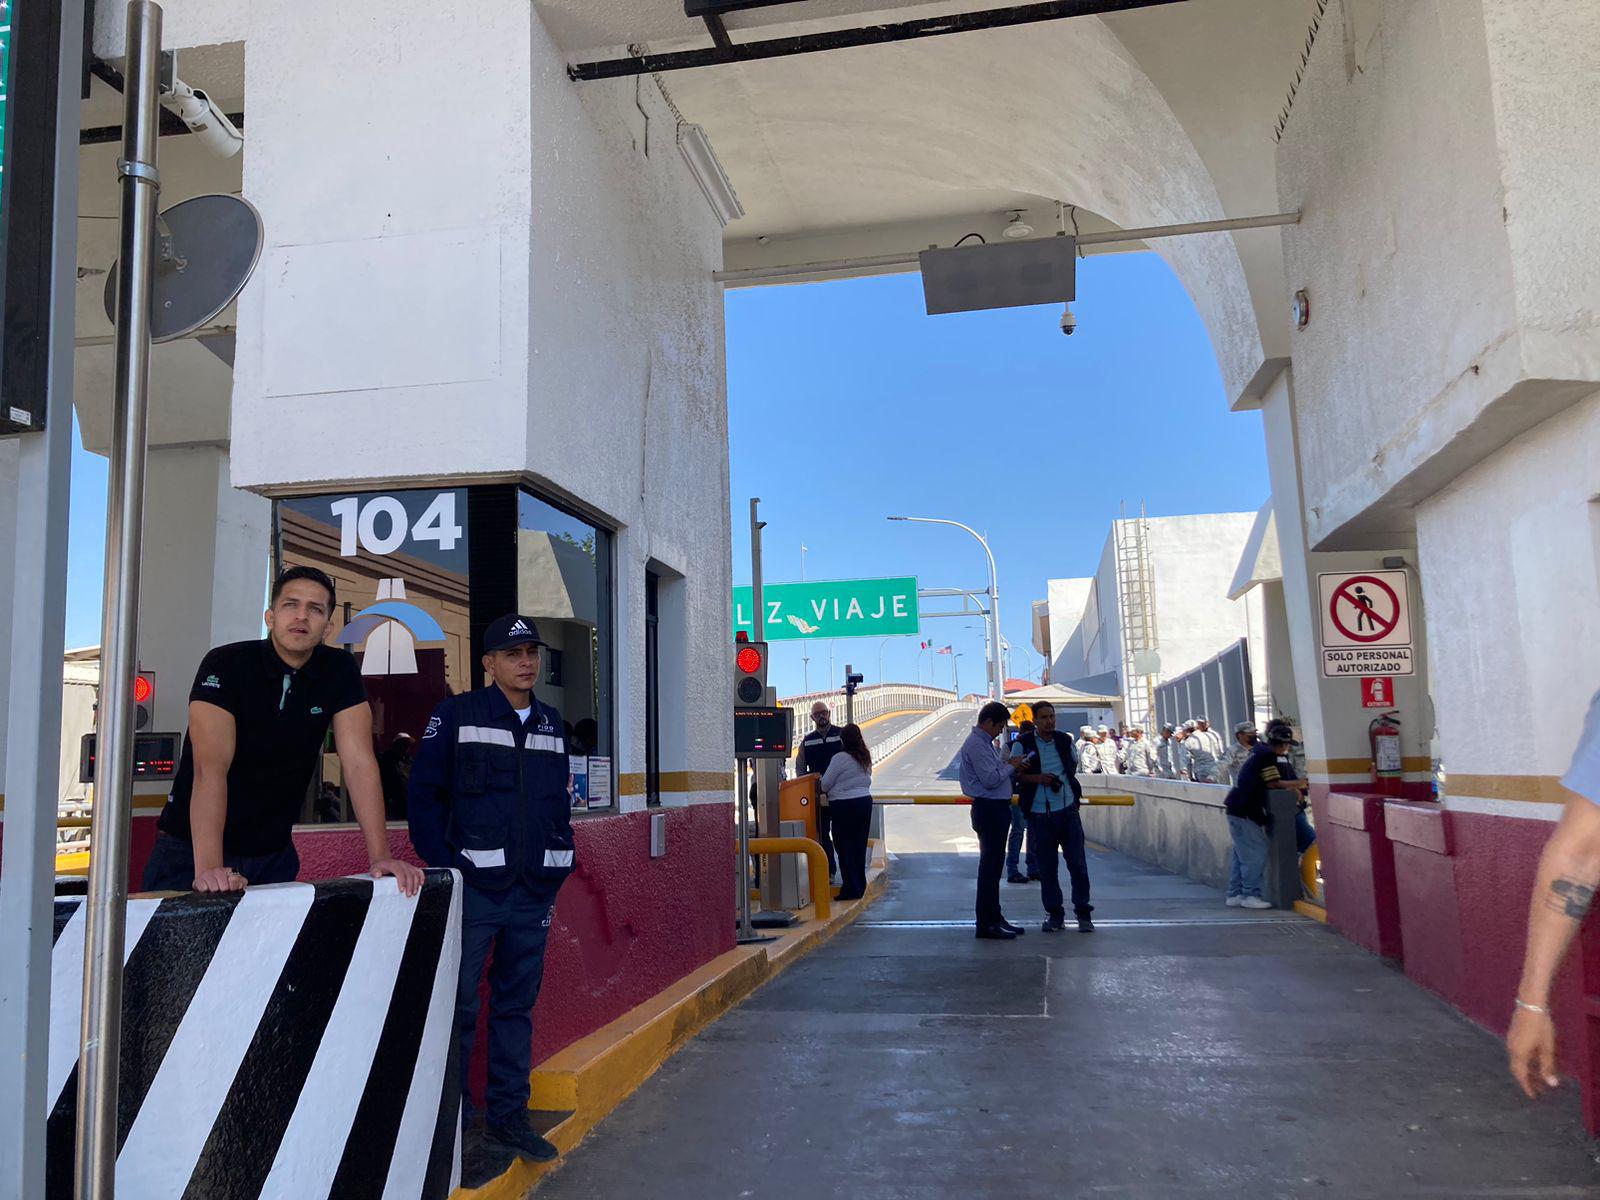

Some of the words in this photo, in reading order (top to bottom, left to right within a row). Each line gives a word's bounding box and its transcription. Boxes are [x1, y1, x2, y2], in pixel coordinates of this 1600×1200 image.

[330, 492, 462, 557] 104
[737, 602, 782, 625] LZ
[811, 595, 908, 621] VIAJE
[1327, 652, 1353, 661] SOLO
[1356, 651, 1409, 660] PERSONAL
[1337, 663, 1400, 673] AUTORIZADO
